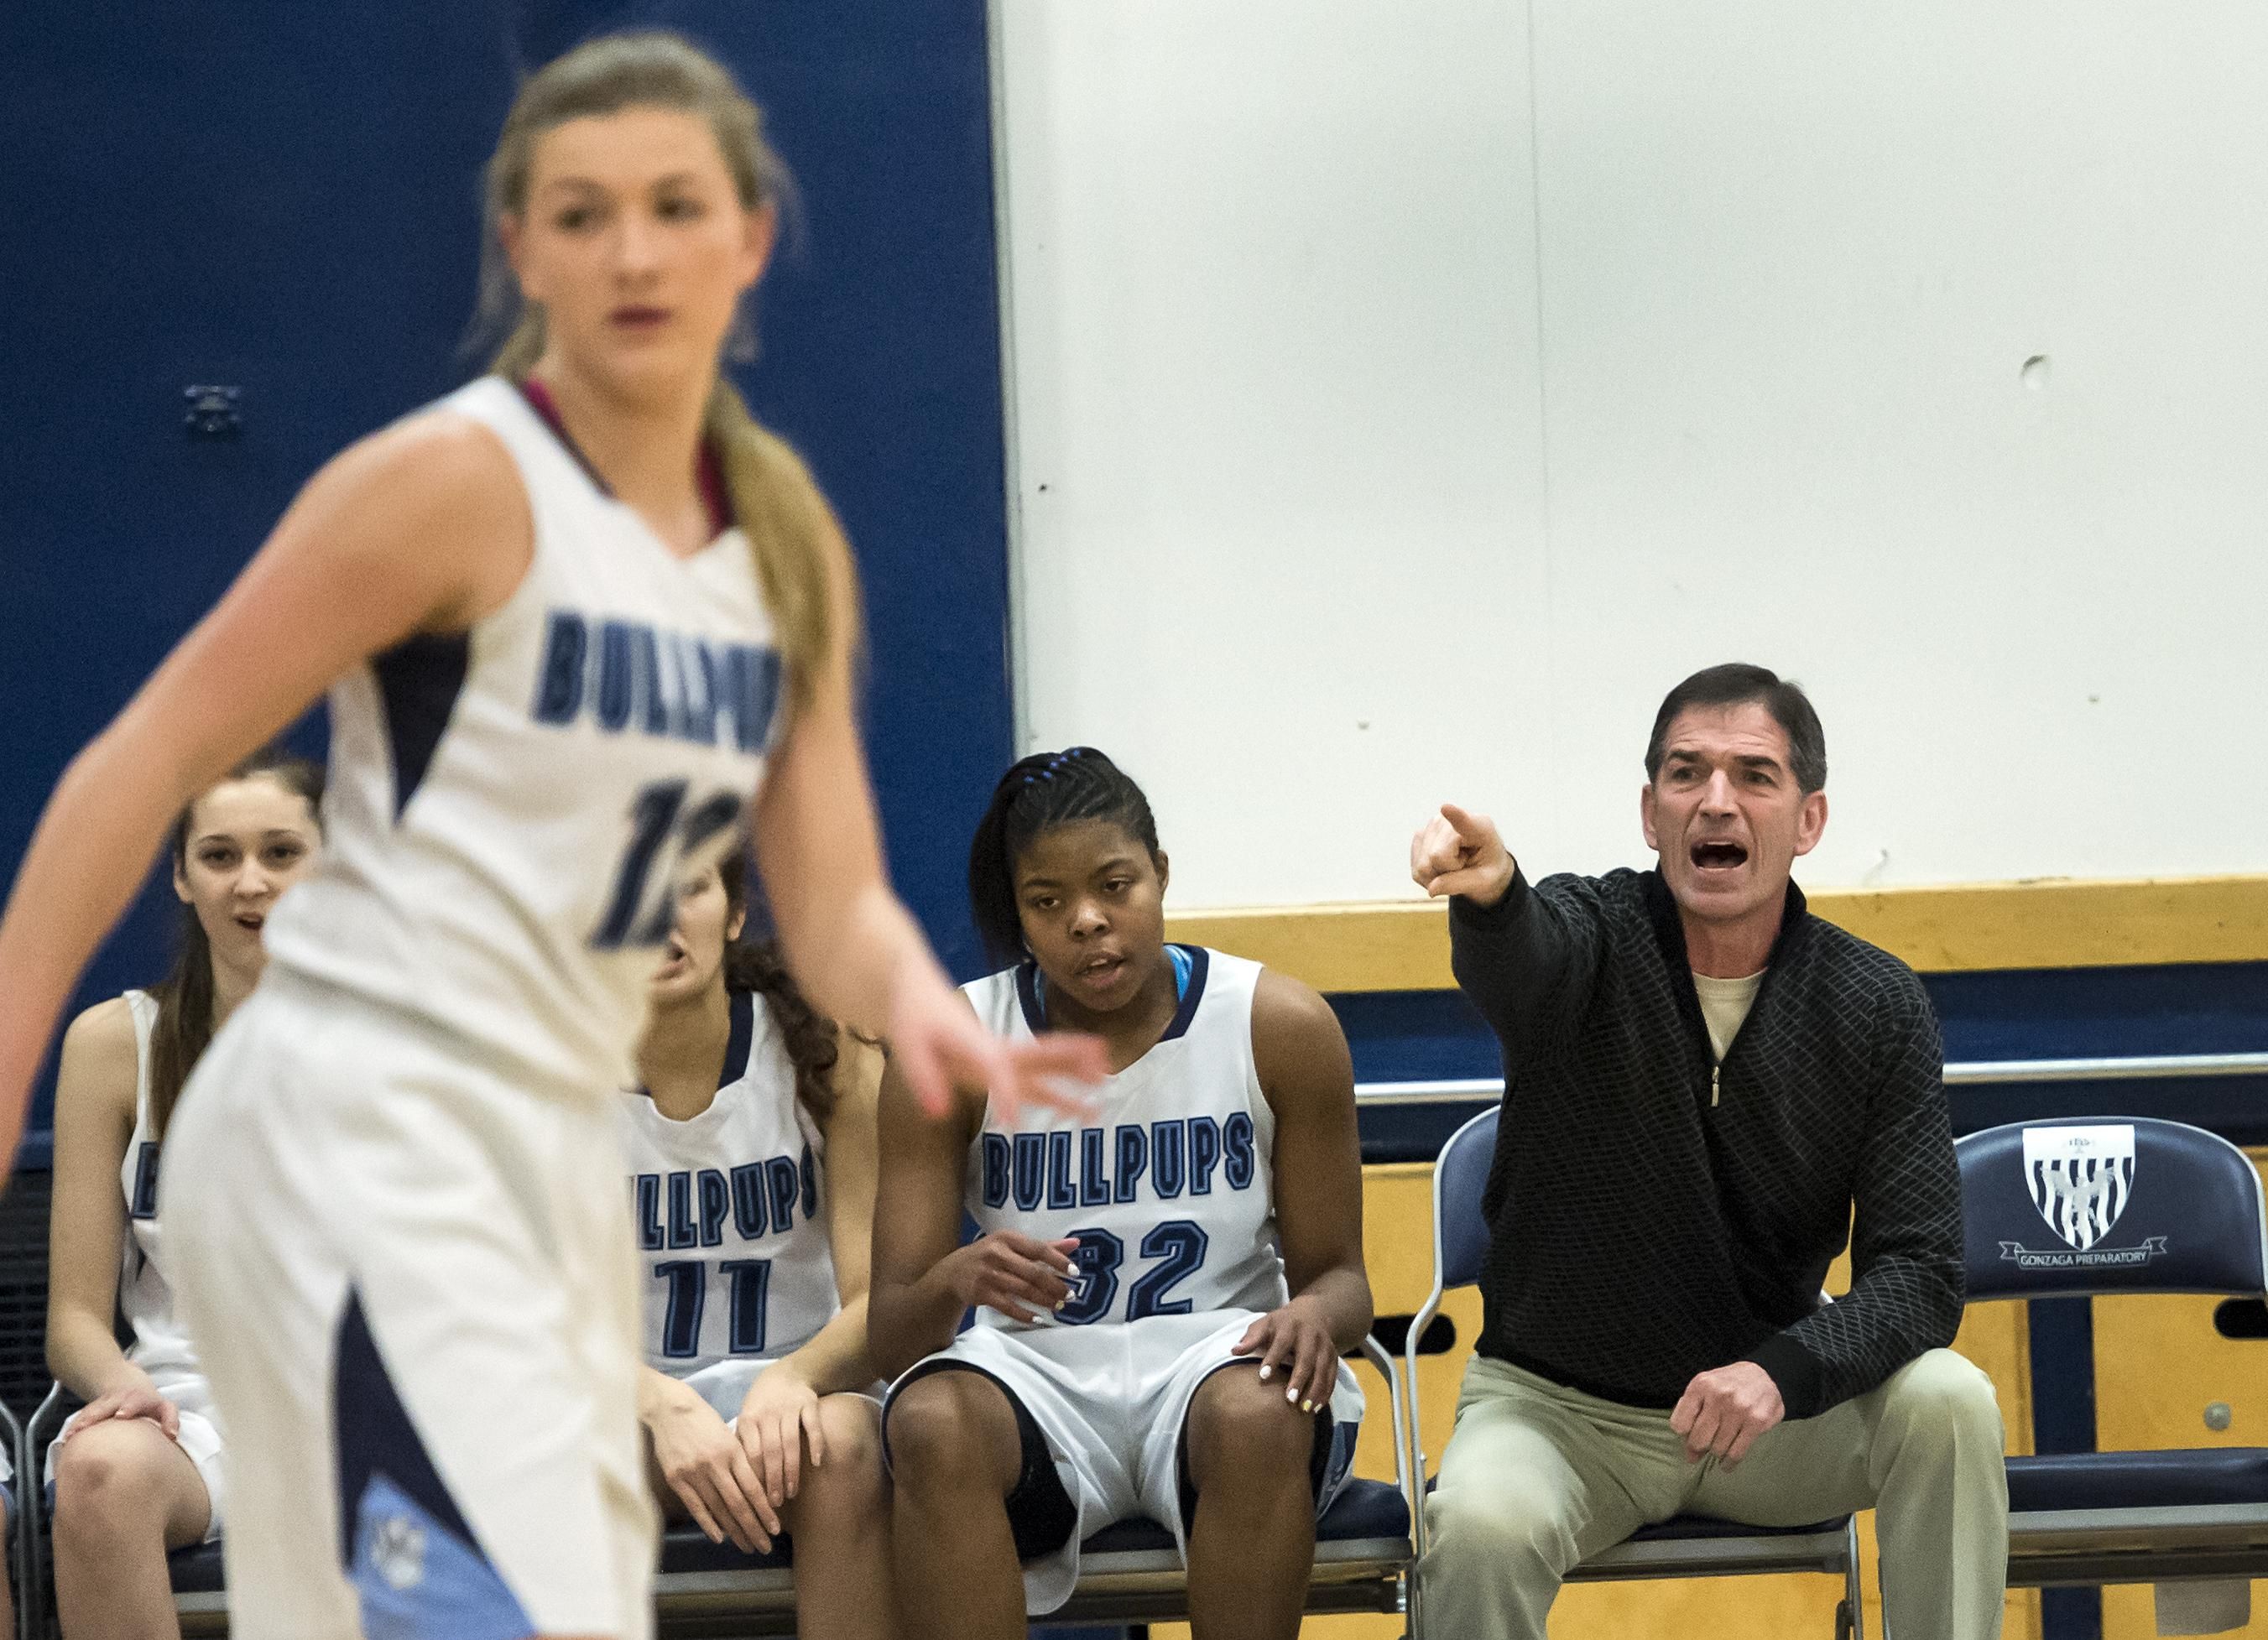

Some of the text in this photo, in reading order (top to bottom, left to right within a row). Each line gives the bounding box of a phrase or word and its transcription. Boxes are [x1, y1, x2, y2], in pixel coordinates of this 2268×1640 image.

[631, 1141, 816, 1250] LLPUPS
[983, 1112, 1254, 1211] BULLPUPS
[654, 1259, 771, 1358] 11
[1054, 1220, 1209, 1325] 32
[2020, 1252, 2145, 1266] GONZAGA PREPARATORY
